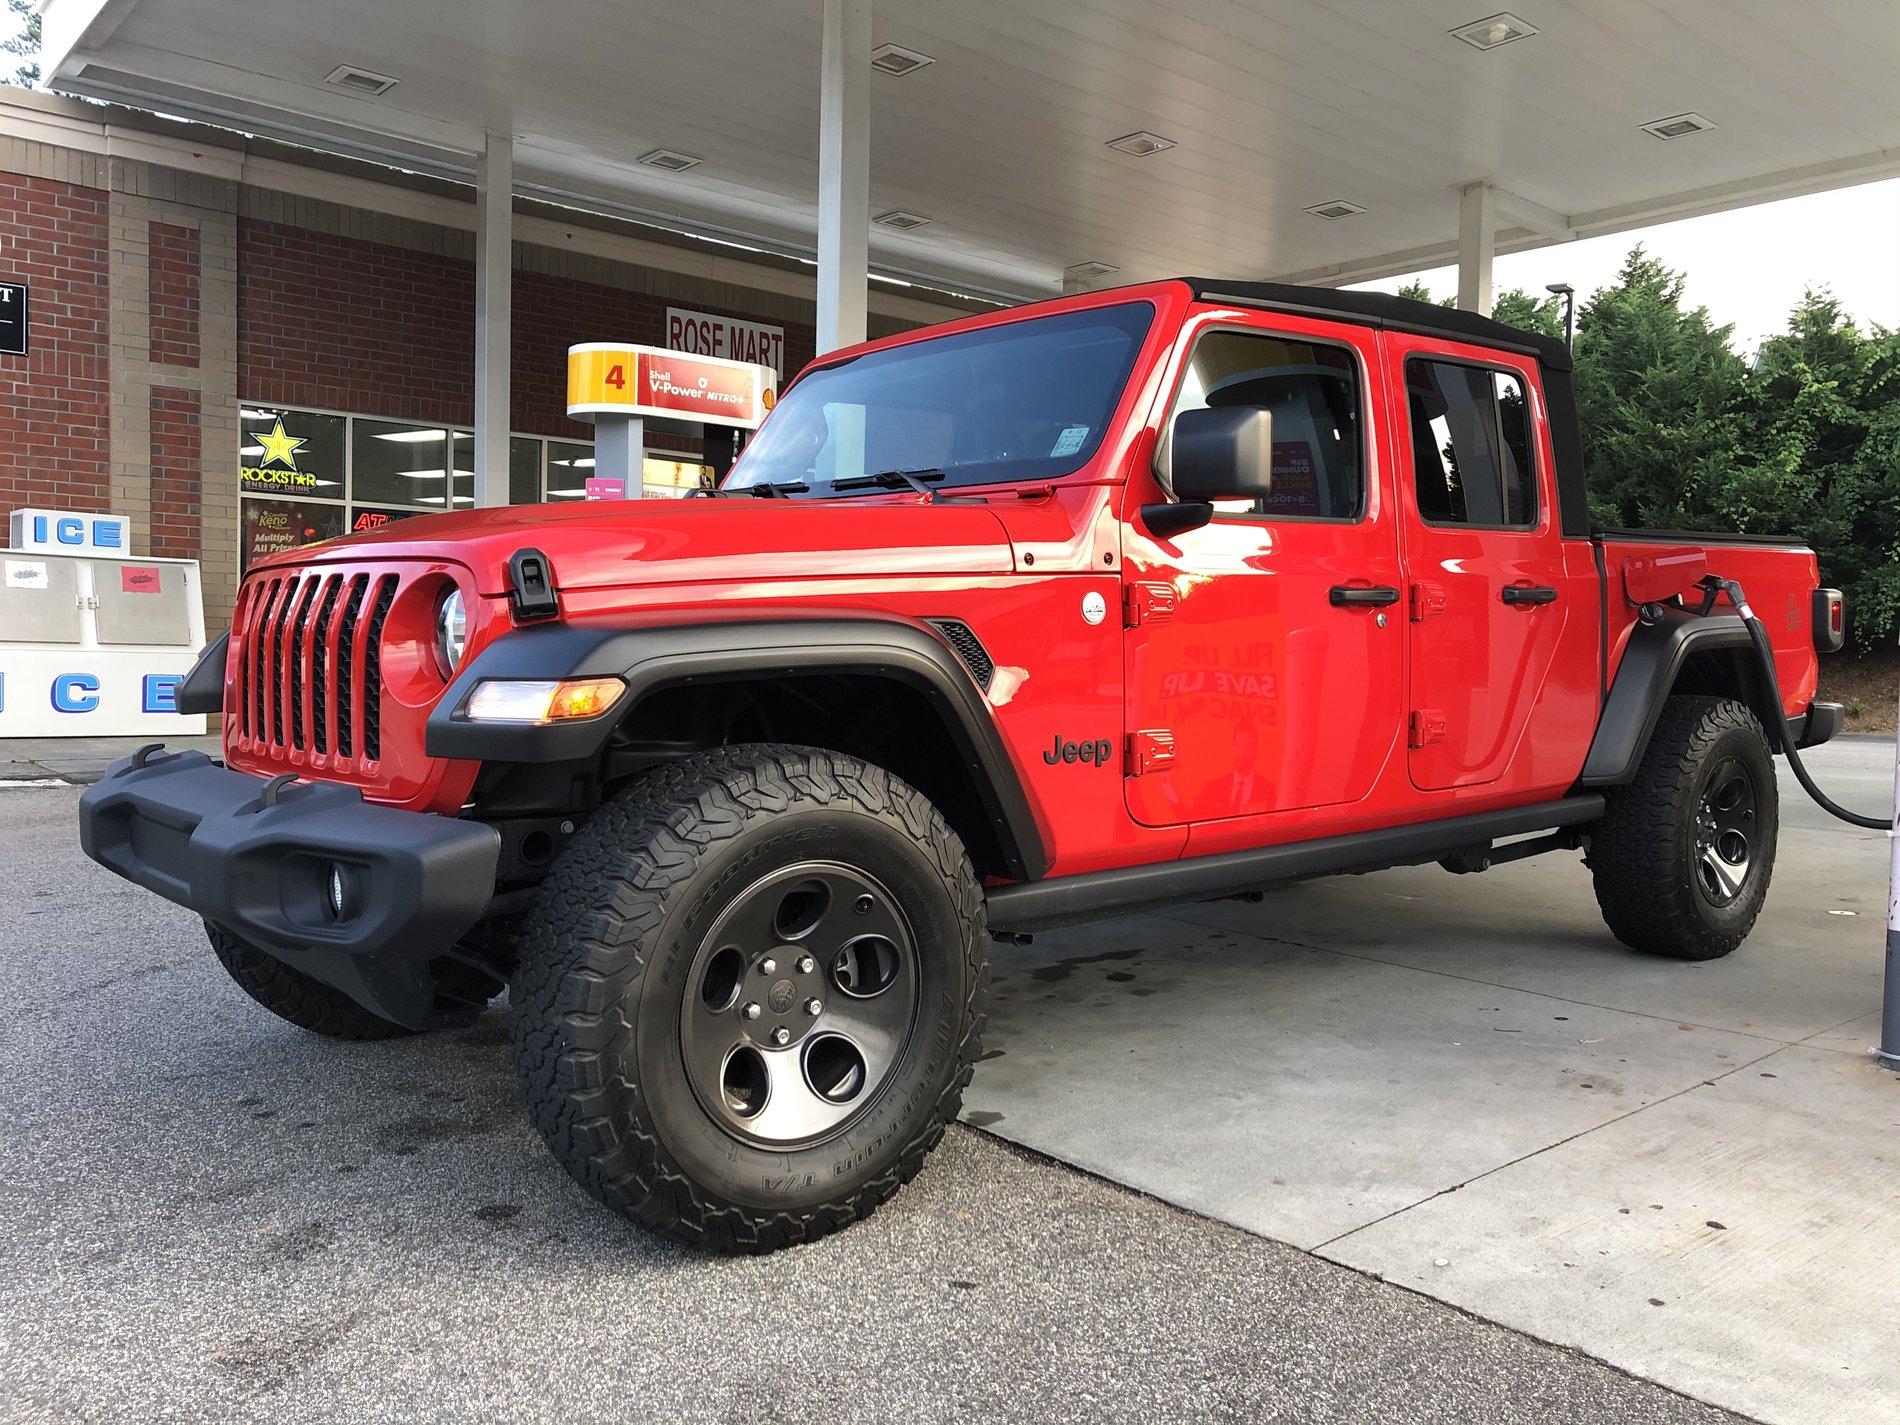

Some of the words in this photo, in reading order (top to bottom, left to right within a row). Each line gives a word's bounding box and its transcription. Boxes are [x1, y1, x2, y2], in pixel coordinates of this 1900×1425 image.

[670, 315, 724, 357] ROSE
[730, 326, 782, 371] MART
[605, 365, 626, 389] 4
[649, 370, 670, 381] Shell
[649, 380, 703, 398] V-Power
[246, 481, 280, 490] ENERGY
[284, 485, 309, 493] DRINK
[258, 515, 288, 527] Keno
[33, 515, 122, 548] ICE
[254, 533, 295, 543] Multiply
[253, 544, 268, 553] All
[0, 671, 184, 714] CE
[1043, 735, 1112, 767] Jeep
[761, 1171, 818, 1193] T/A
